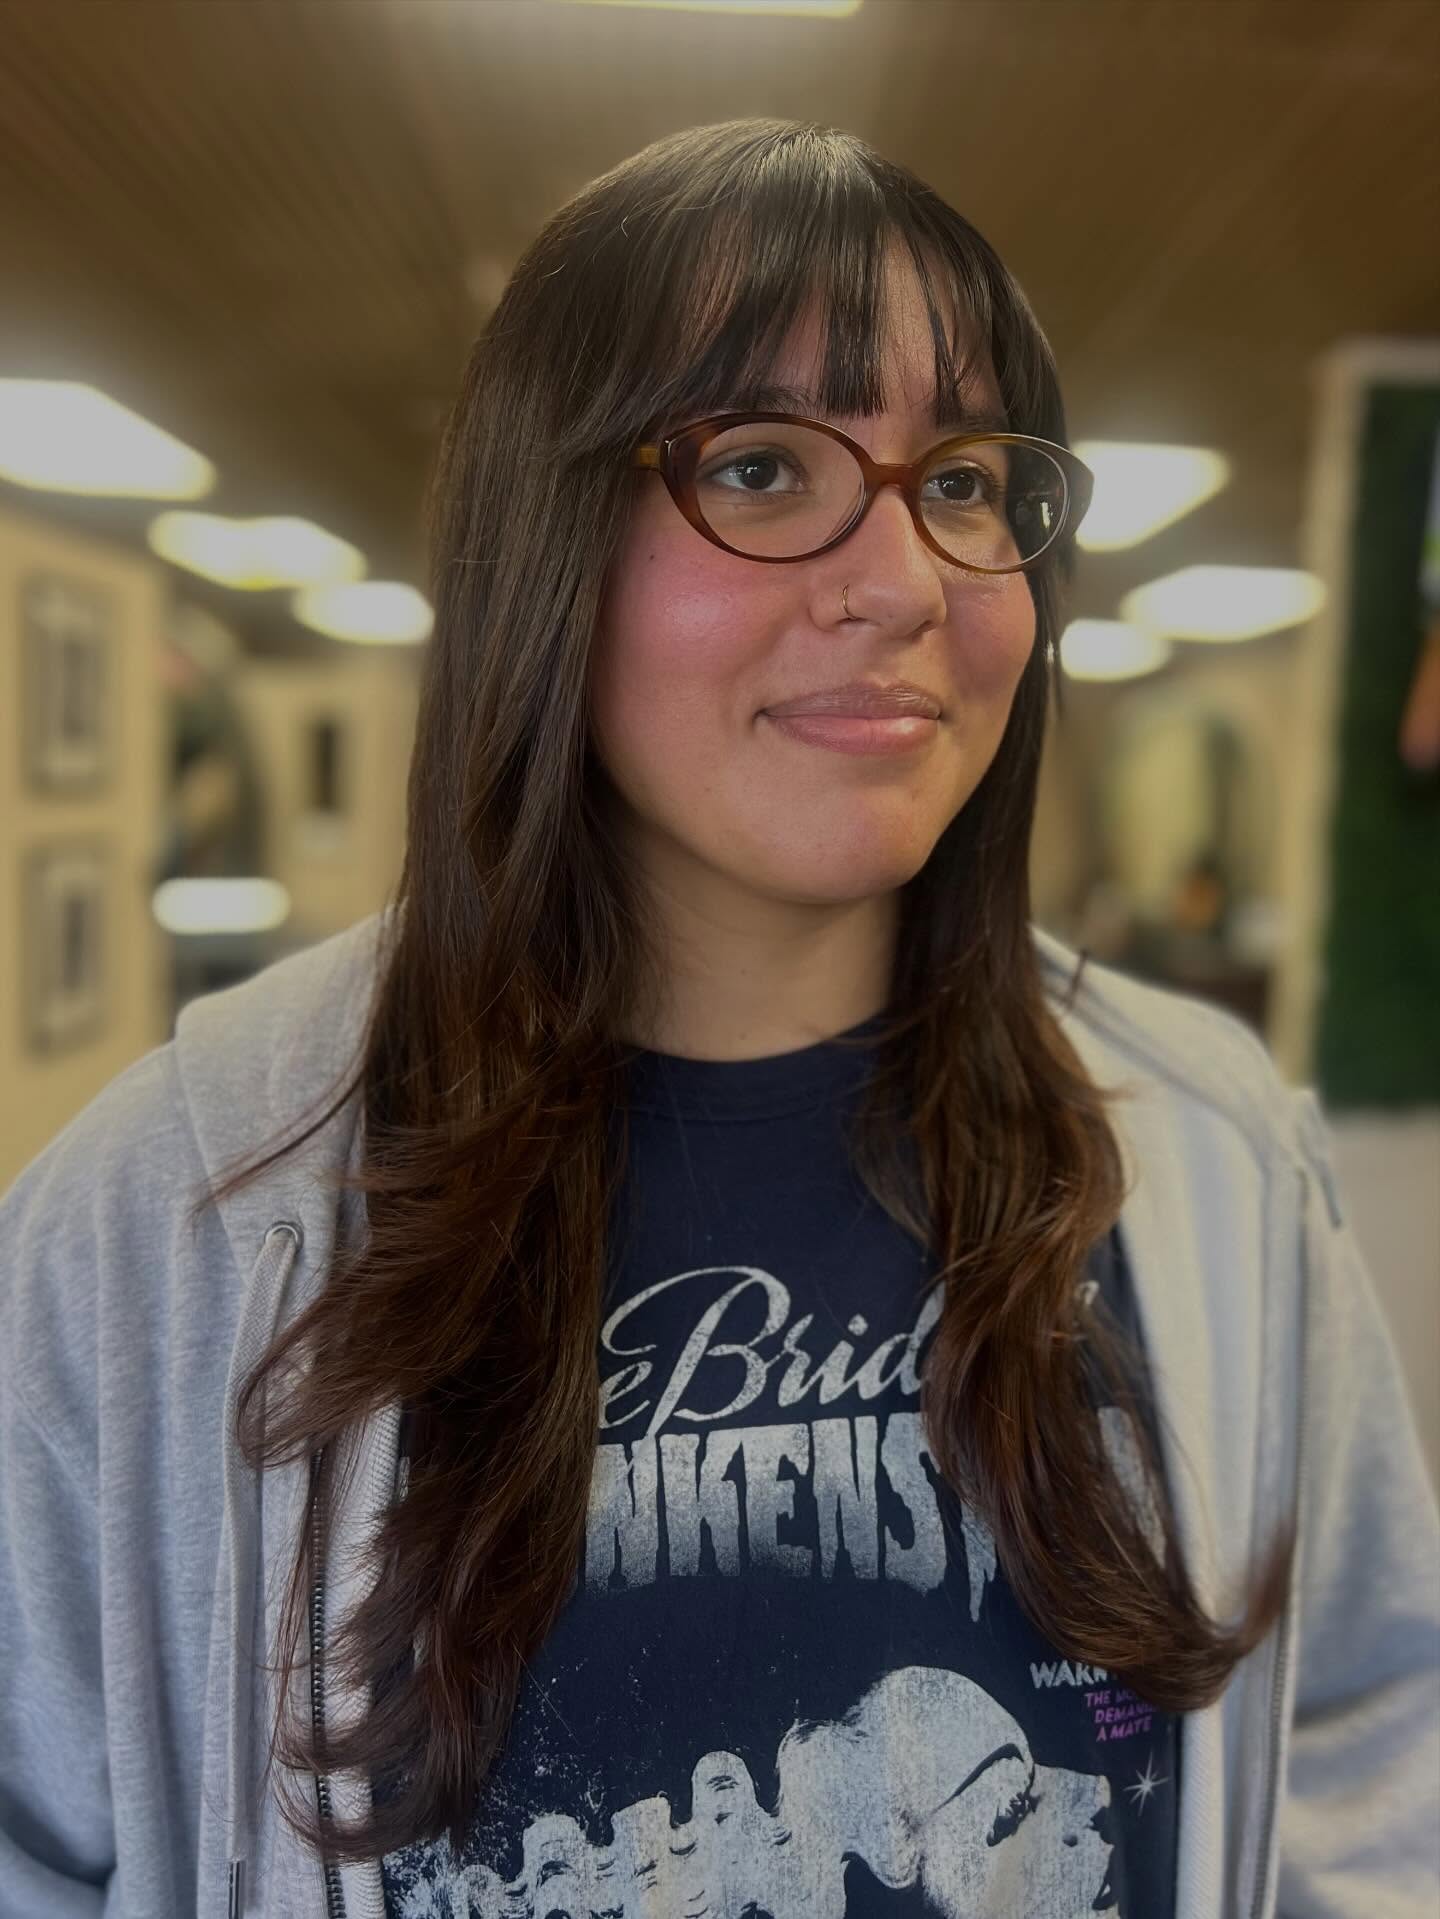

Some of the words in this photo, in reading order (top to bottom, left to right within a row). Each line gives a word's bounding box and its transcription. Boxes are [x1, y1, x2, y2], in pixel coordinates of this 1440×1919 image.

[602, 1265, 945, 1438] Brid
[585, 1411, 997, 1622] NKENS
[1084, 1690, 1111, 1707] THE
[1096, 1726, 1107, 1742] A
[1110, 1716, 1152, 1739] MATE
